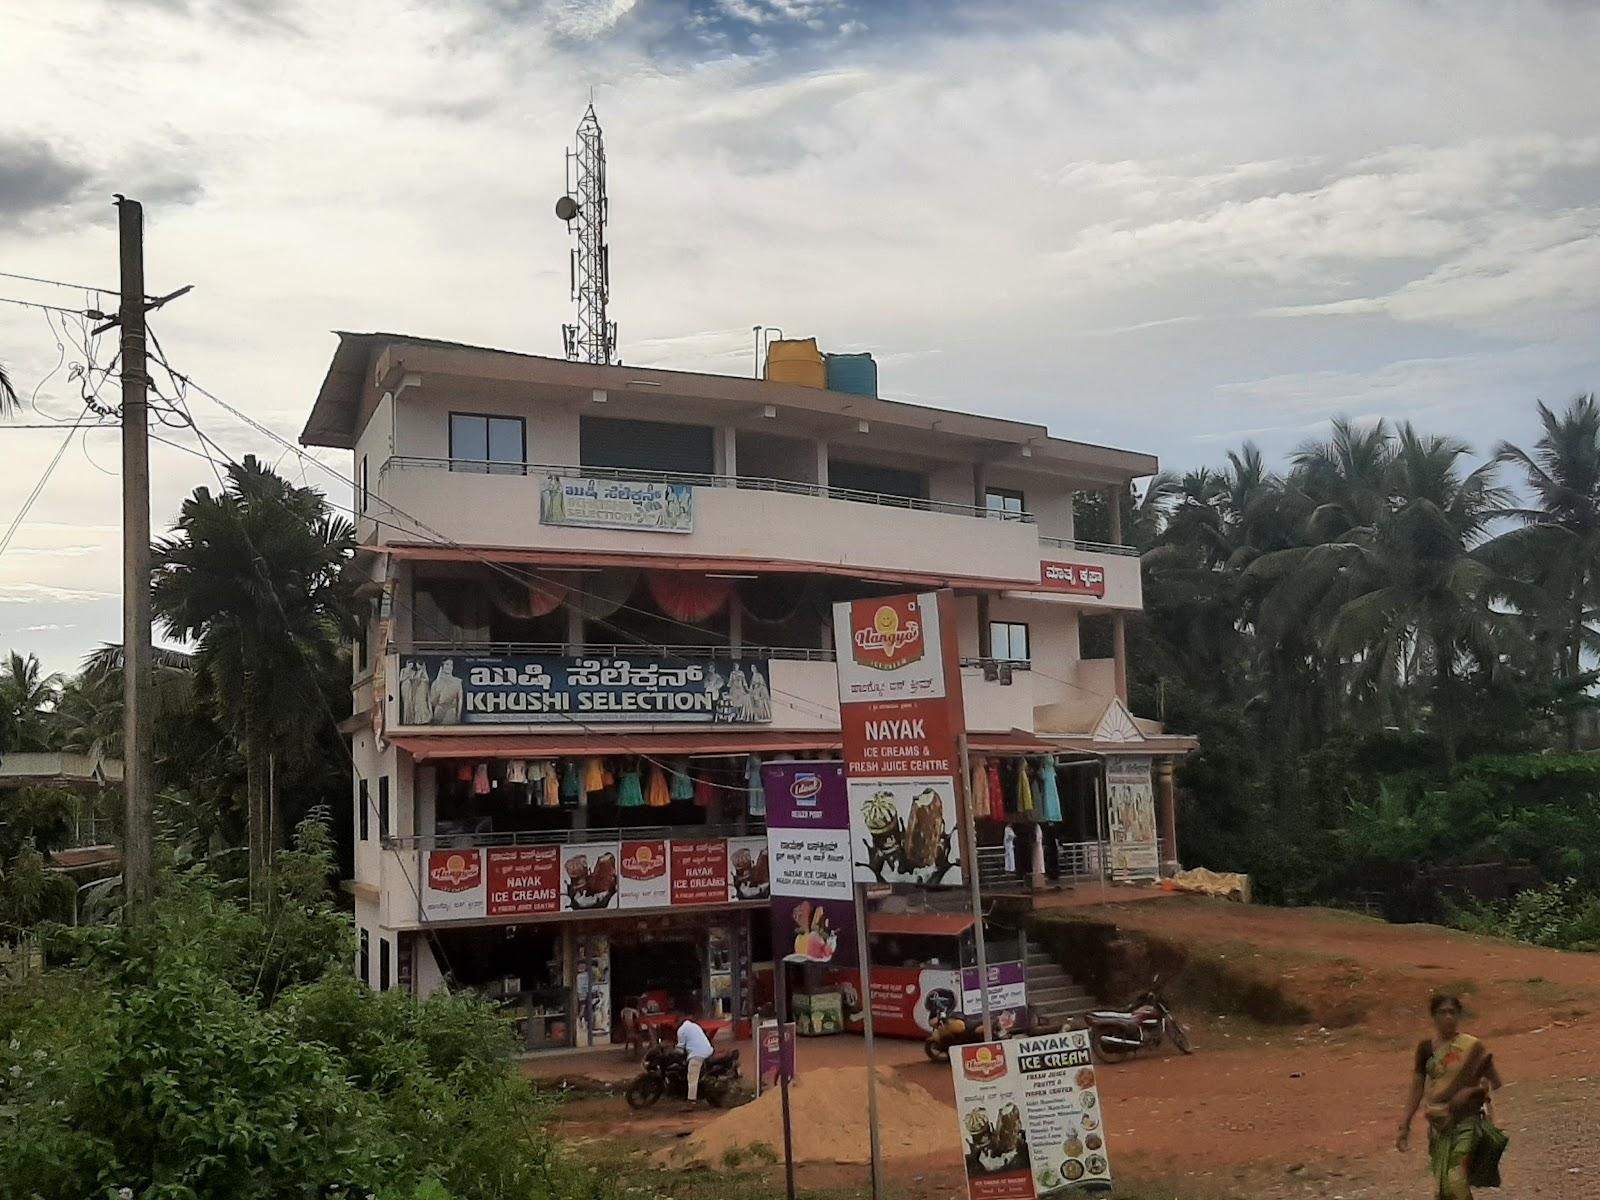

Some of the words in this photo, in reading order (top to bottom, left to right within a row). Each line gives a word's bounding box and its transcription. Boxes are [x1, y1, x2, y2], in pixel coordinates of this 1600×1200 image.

[567, 508, 632, 521] SELECTION
[470, 663, 551, 690] ಖುಷಿ
[566, 658, 704, 692] ಸೆಲೆಕ್ಷನ್
[466, 692, 570, 713] KHUSHI
[578, 691, 713, 711] SELECTION
[864, 719, 926, 741] NAYAK
[863, 747, 878, 758] ICE
[881, 746, 920, 757] CREAMS
[922, 746, 930, 756] &
[849, 761, 878, 772] FRESH
[881, 761, 908, 772] JUICE
[910, 760, 949, 771] CENTRE
[685, 867, 713, 877] NAYAK
[507, 876, 541, 888] NAYAK
[674, 879, 688, 889] ICE
[690, 877, 726, 888] CREAMS
[491, 891, 509, 902] ICE
[512, 888, 557, 901] CREAMS
[1019, 1036, 1070, 1054] NAYAK
[1020, 1055, 1042, 1070] ICE
[1044, 1050, 1090, 1067] CREAM
